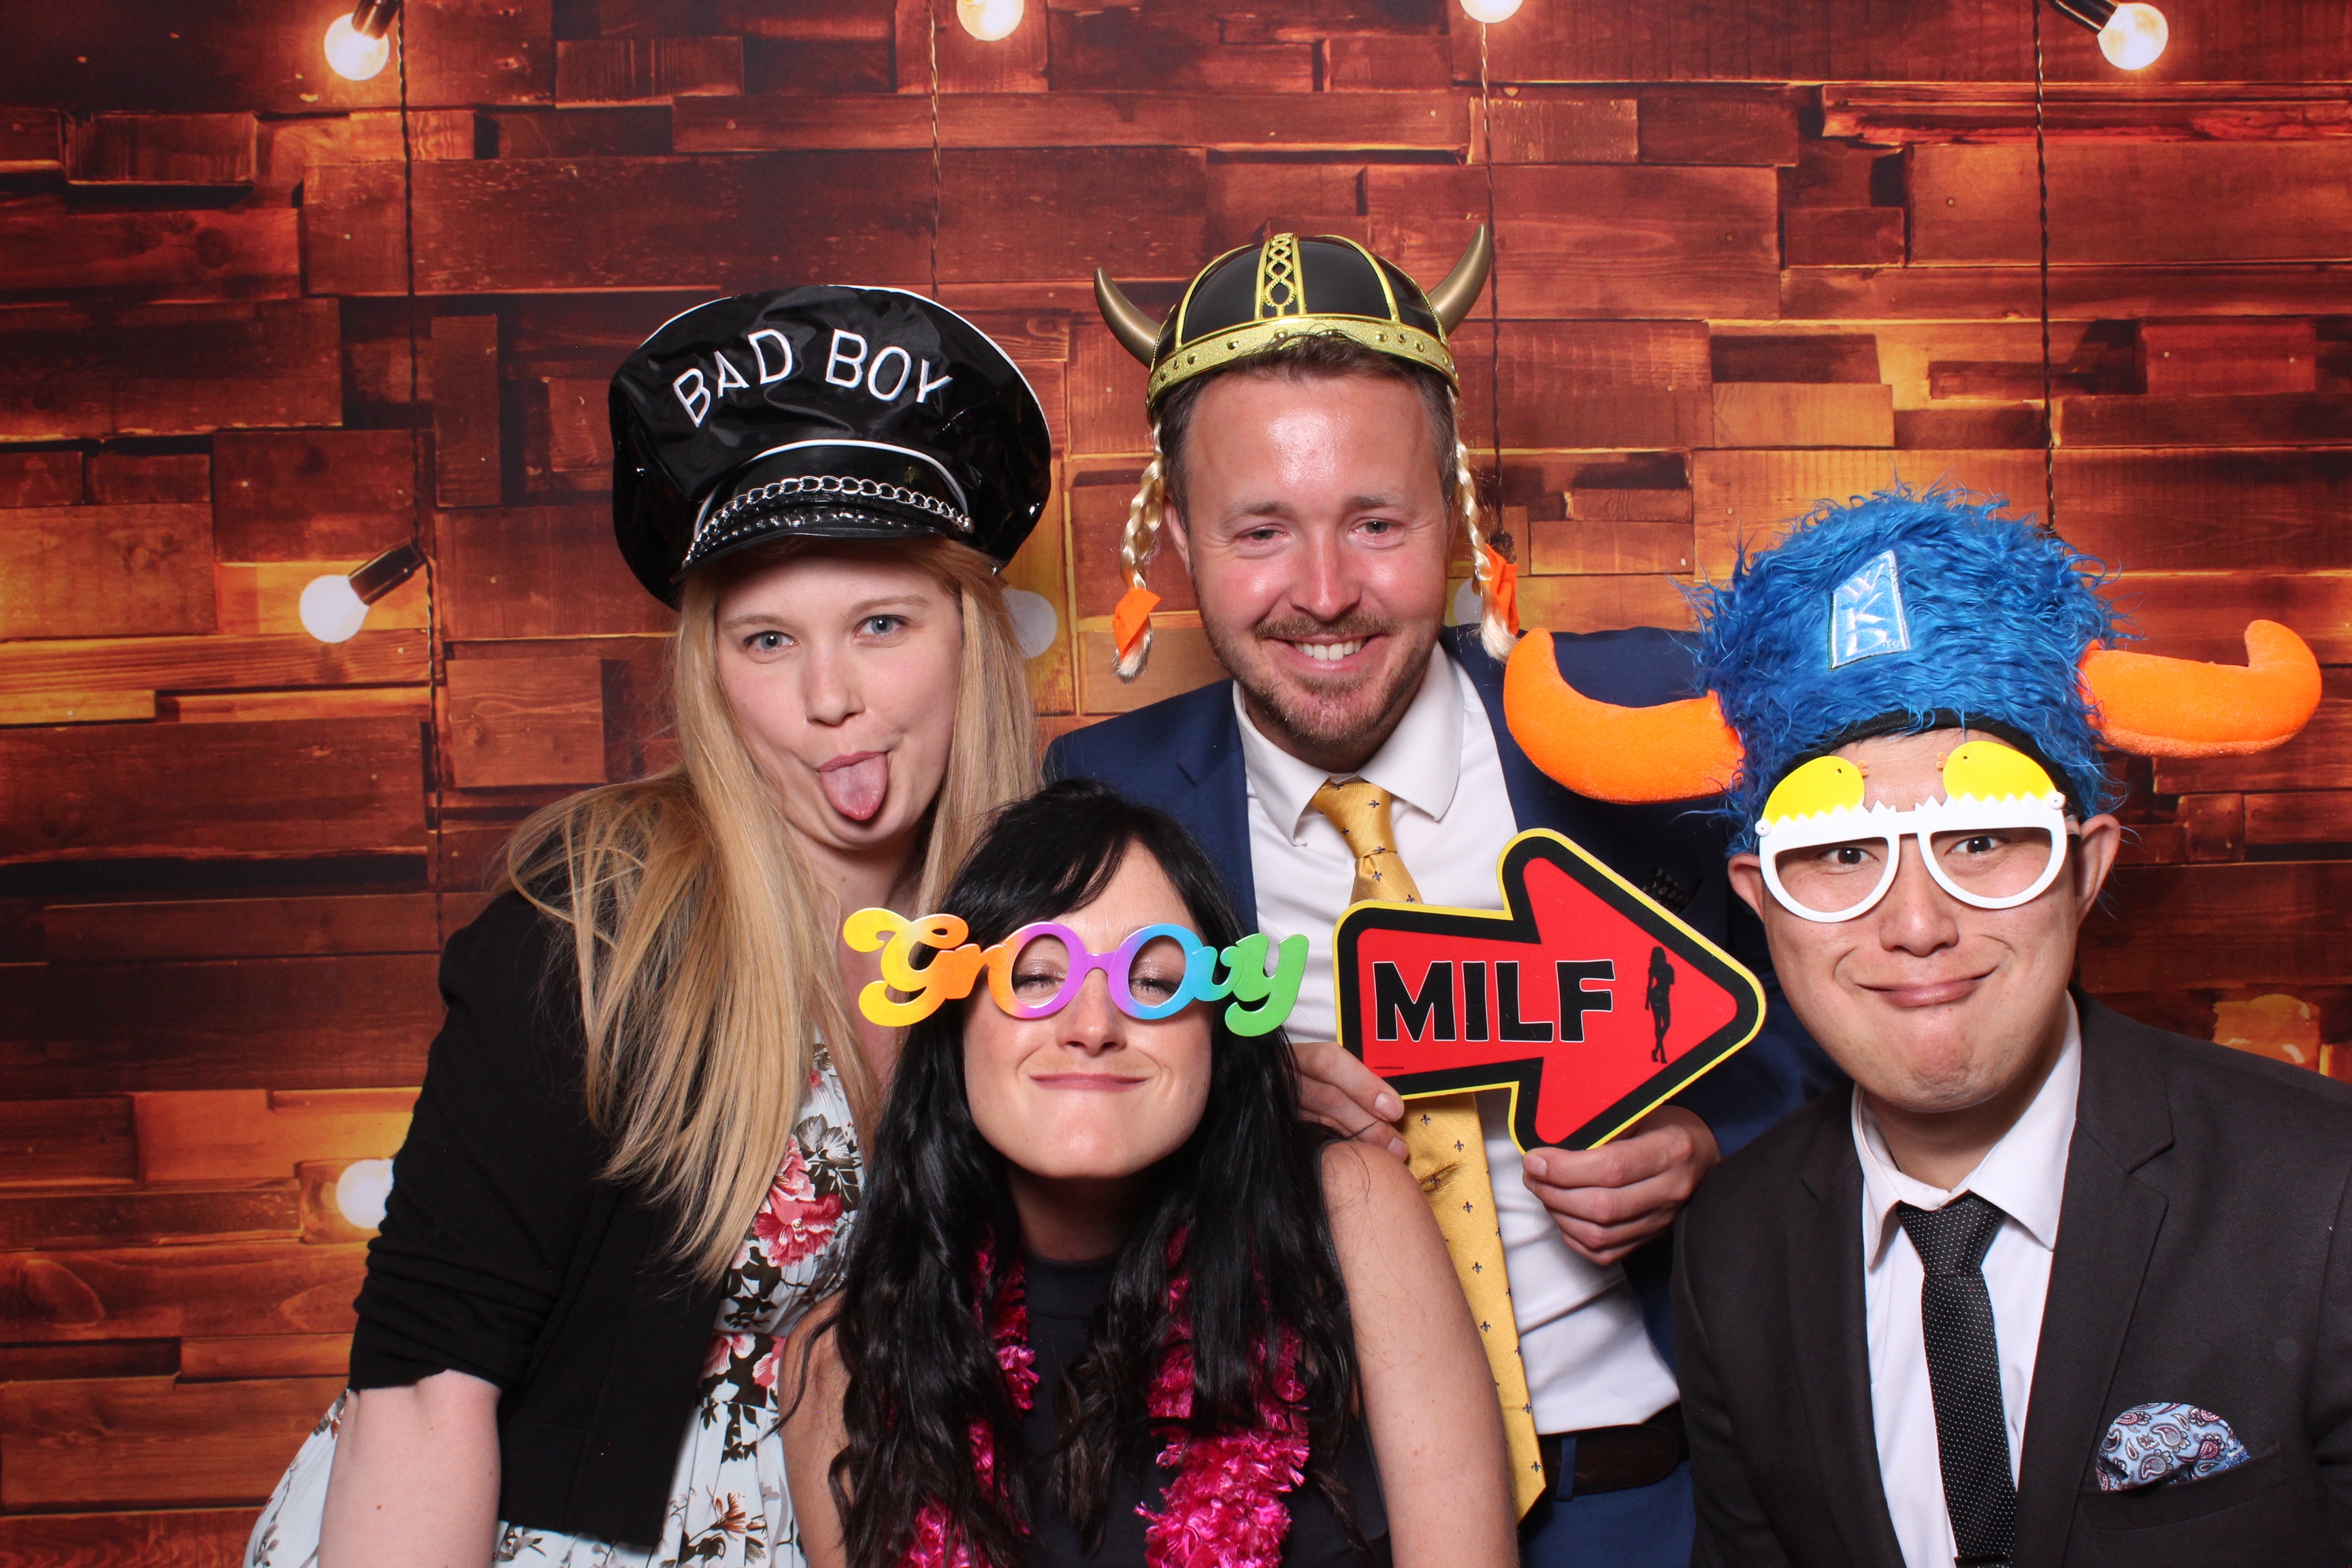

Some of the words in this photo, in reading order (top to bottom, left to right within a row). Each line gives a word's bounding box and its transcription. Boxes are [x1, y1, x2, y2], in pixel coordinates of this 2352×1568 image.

[673, 329, 793, 427] BAD
[826, 329, 953, 403] BOY
[1373, 960, 1616, 1043] MILF
